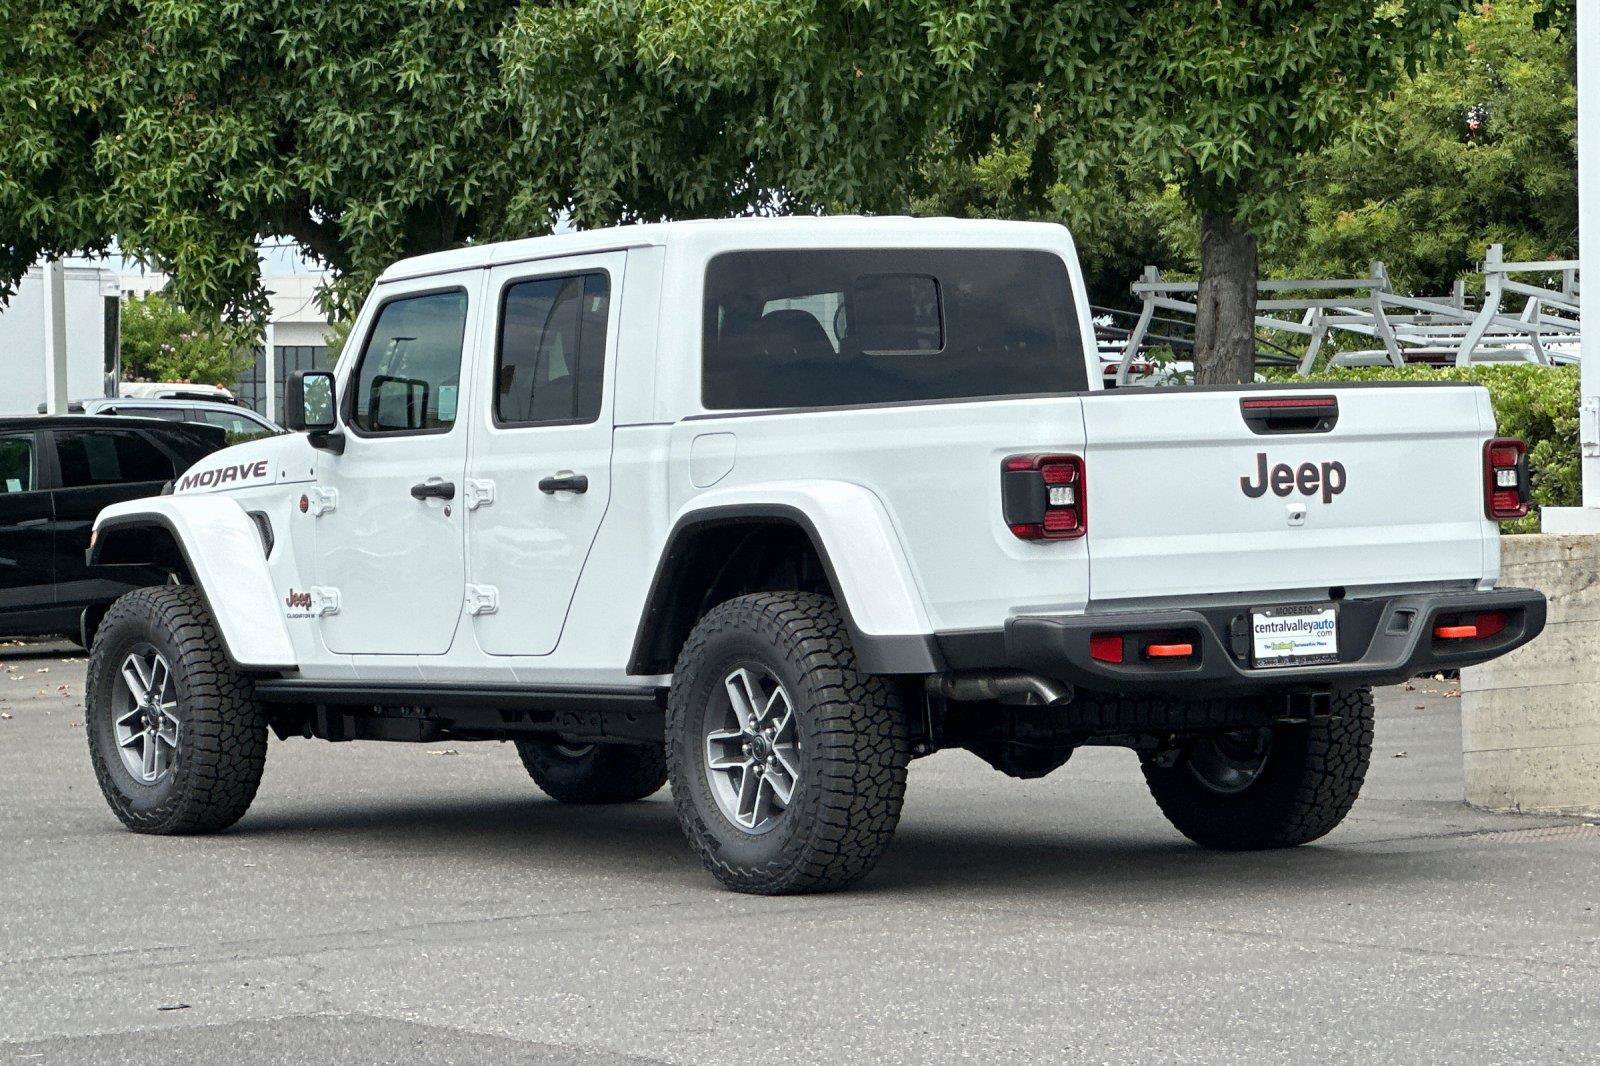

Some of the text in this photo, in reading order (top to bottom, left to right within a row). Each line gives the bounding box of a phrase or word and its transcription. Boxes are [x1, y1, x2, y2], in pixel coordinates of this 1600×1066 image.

[179, 460, 268, 491] MOJAVE
[1240, 453, 1346, 504] Jeep
[285, 588, 312, 611] Jeep
[1276, 605, 1313, 615] MODESTO
[1254, 619, 1335, 634] centralvalleyauto
